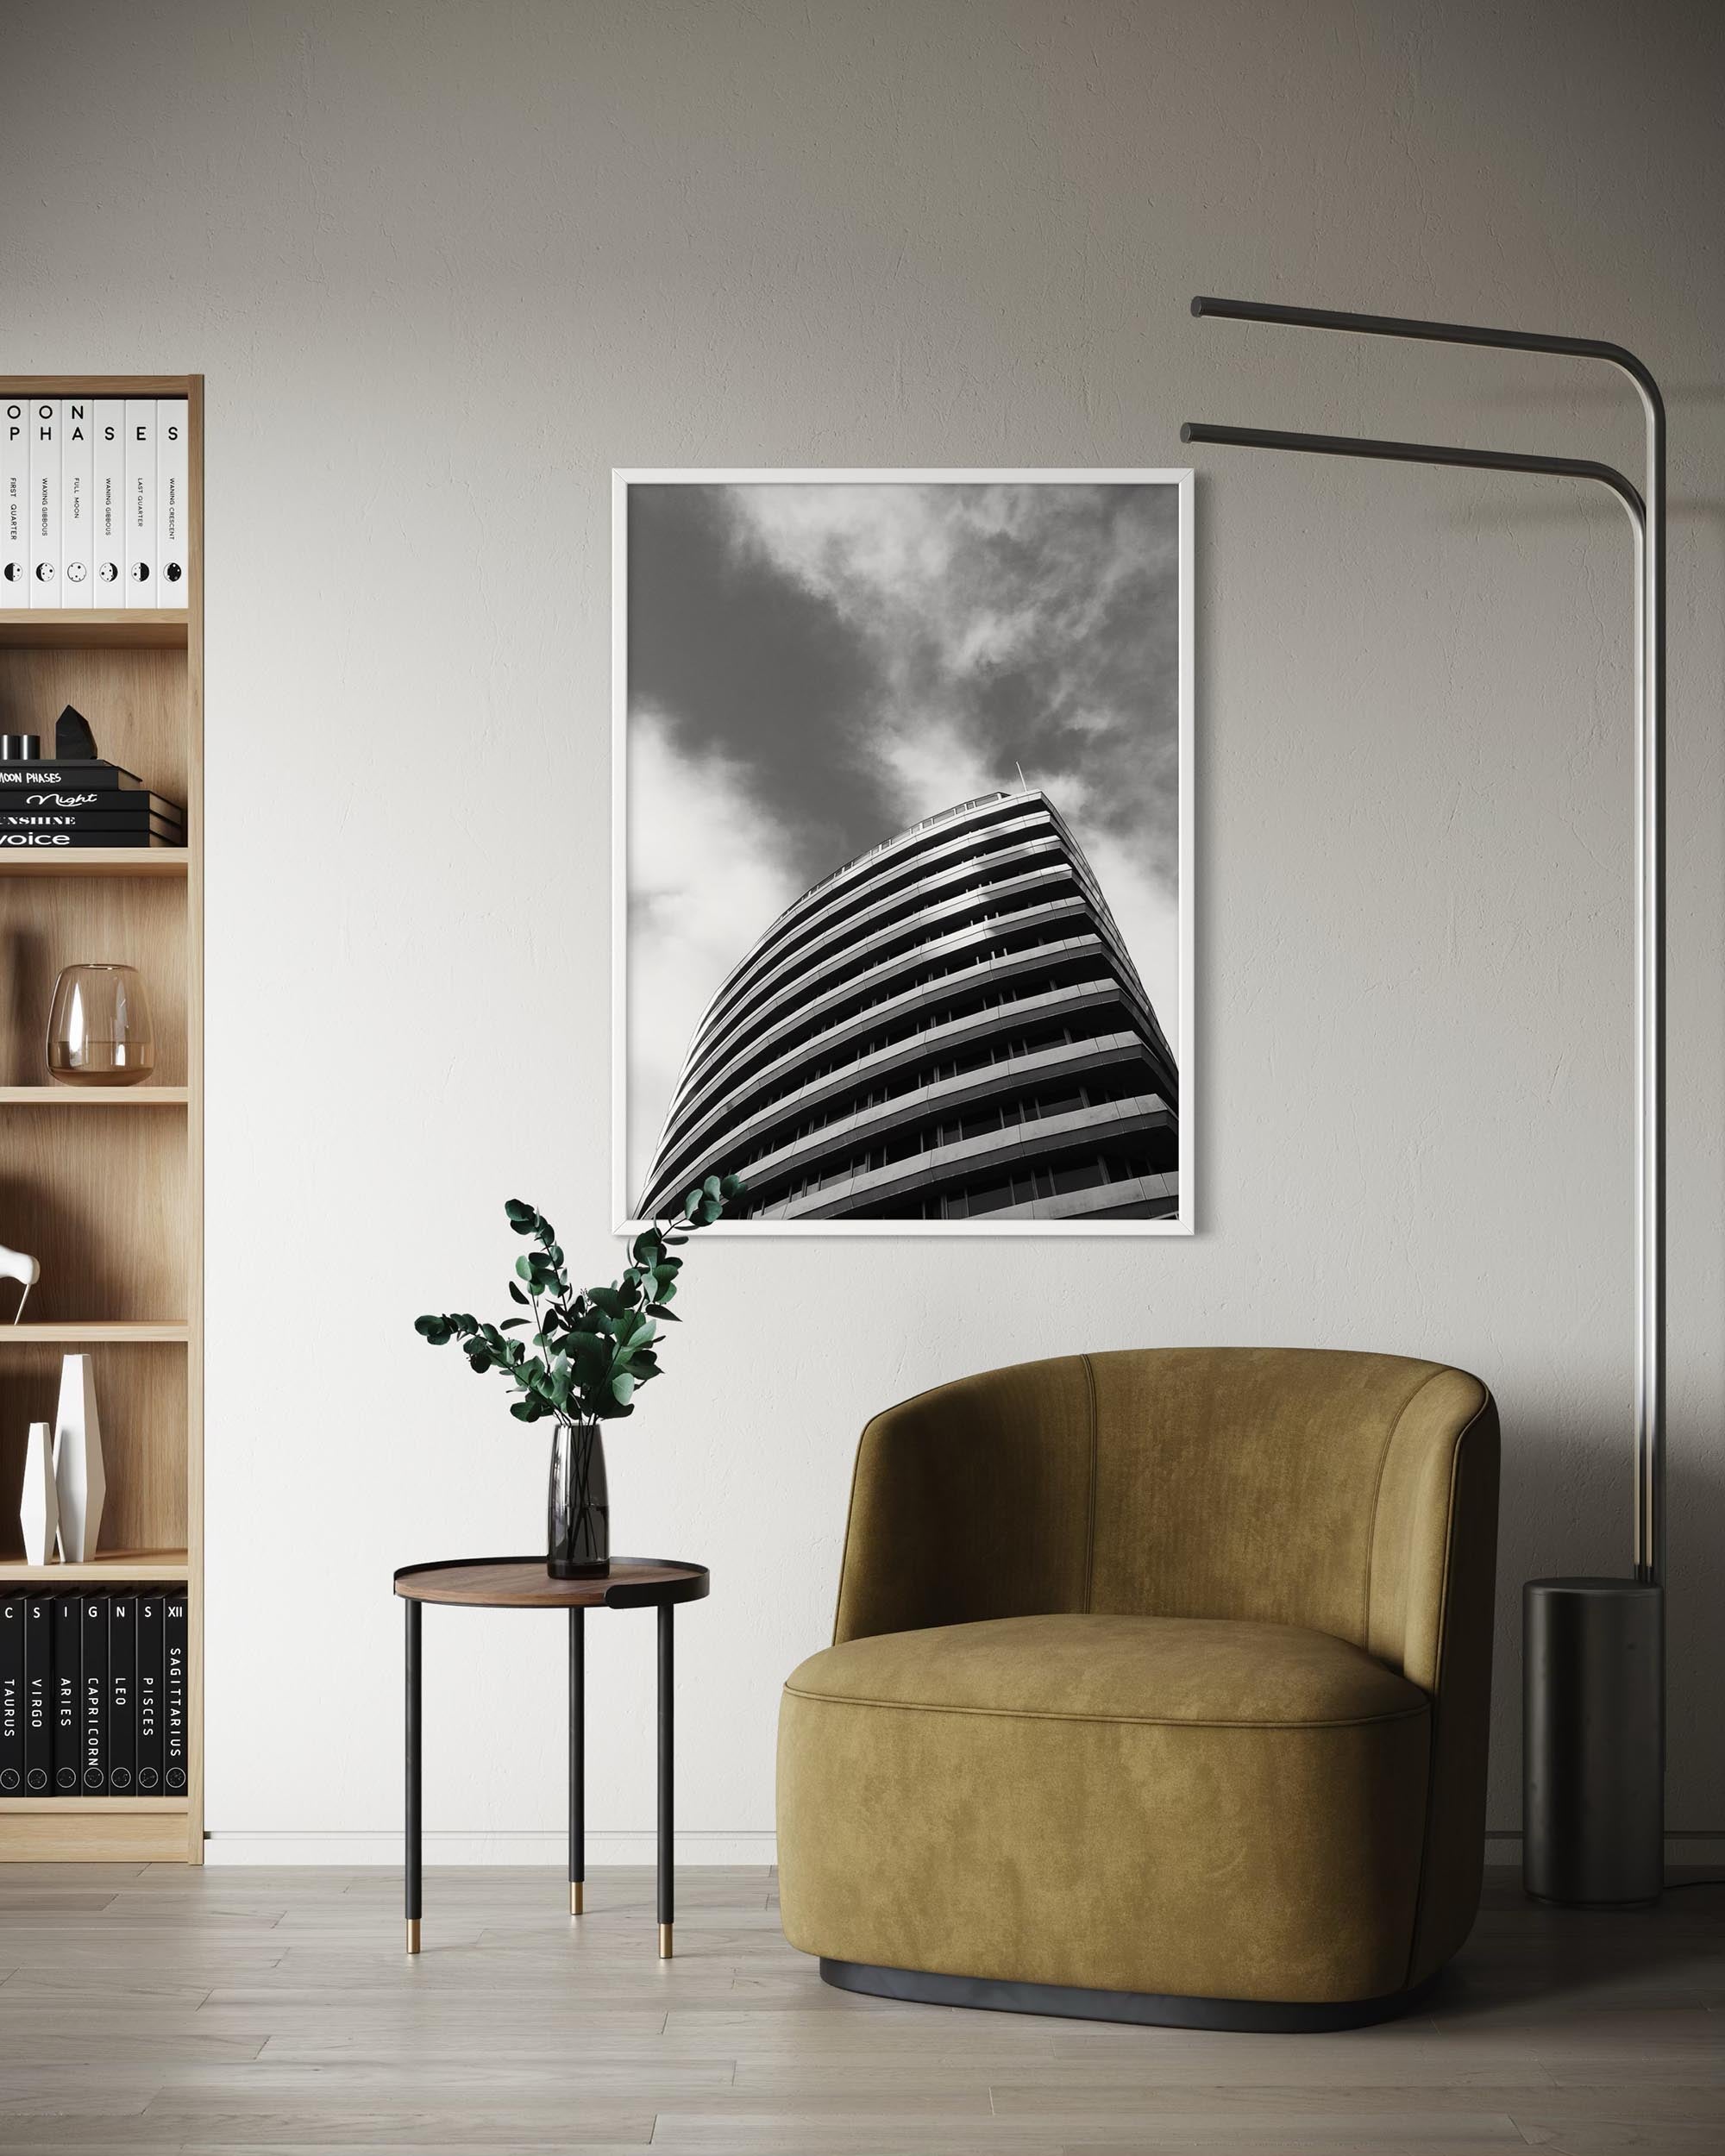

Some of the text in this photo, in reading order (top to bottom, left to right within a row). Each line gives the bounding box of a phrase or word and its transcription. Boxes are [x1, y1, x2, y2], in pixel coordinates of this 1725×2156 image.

[9, 504, 18, 541] QUARTER
[26, 772, 62, 784] PHASES
[26, 793, 97, 807] Night
[167, 1606, 183, 1618] XII
[3, 1678, 16, 1737] TAURUS
[31, 1678, 42, 1727] VIRGO
[60, 1677, 72, 1727] ARIES
[115, 1677, 127, 1705] LEO
[142, 1677, 154, 1736] PISCES
[170, 1647, 181, 1757] SAGITTARIUS
[88, 1677, 99, 1766] CAPRICORN
